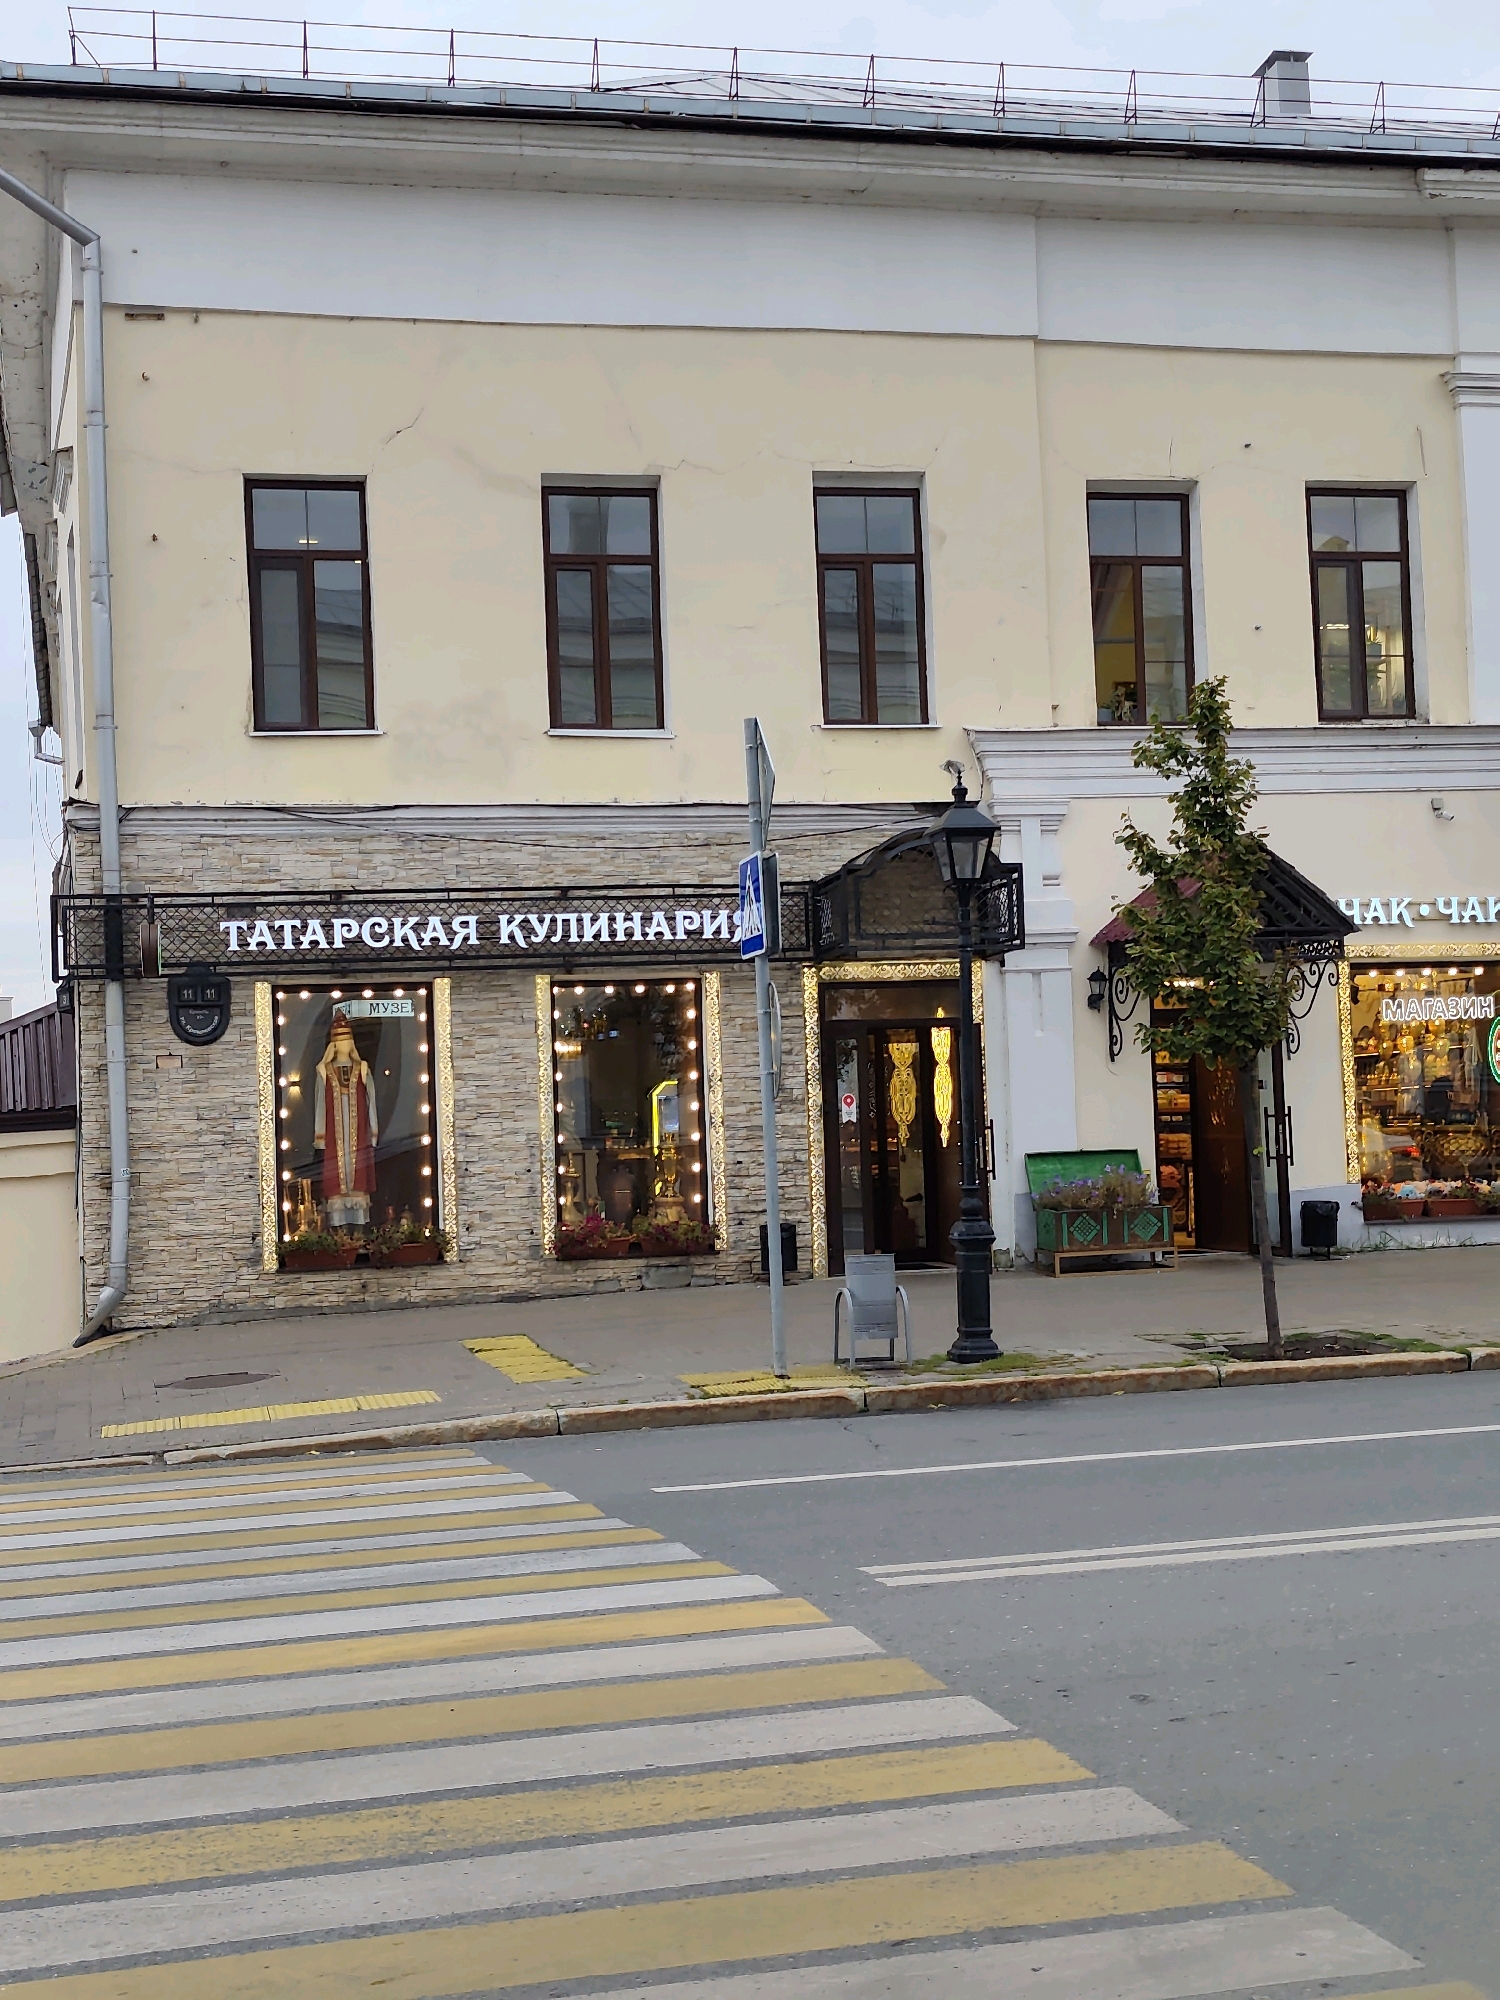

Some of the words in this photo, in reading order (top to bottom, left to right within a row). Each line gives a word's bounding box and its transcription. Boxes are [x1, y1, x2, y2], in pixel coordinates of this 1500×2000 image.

[1336, 897, 1415, 928] ЧАК
[219, 915, 480, 951] ТАТАРСКАЯ
[369, 1002, 414, 1016] МУЗЕ
[1382, 996, 1495, 1021] МАГАЗИН
